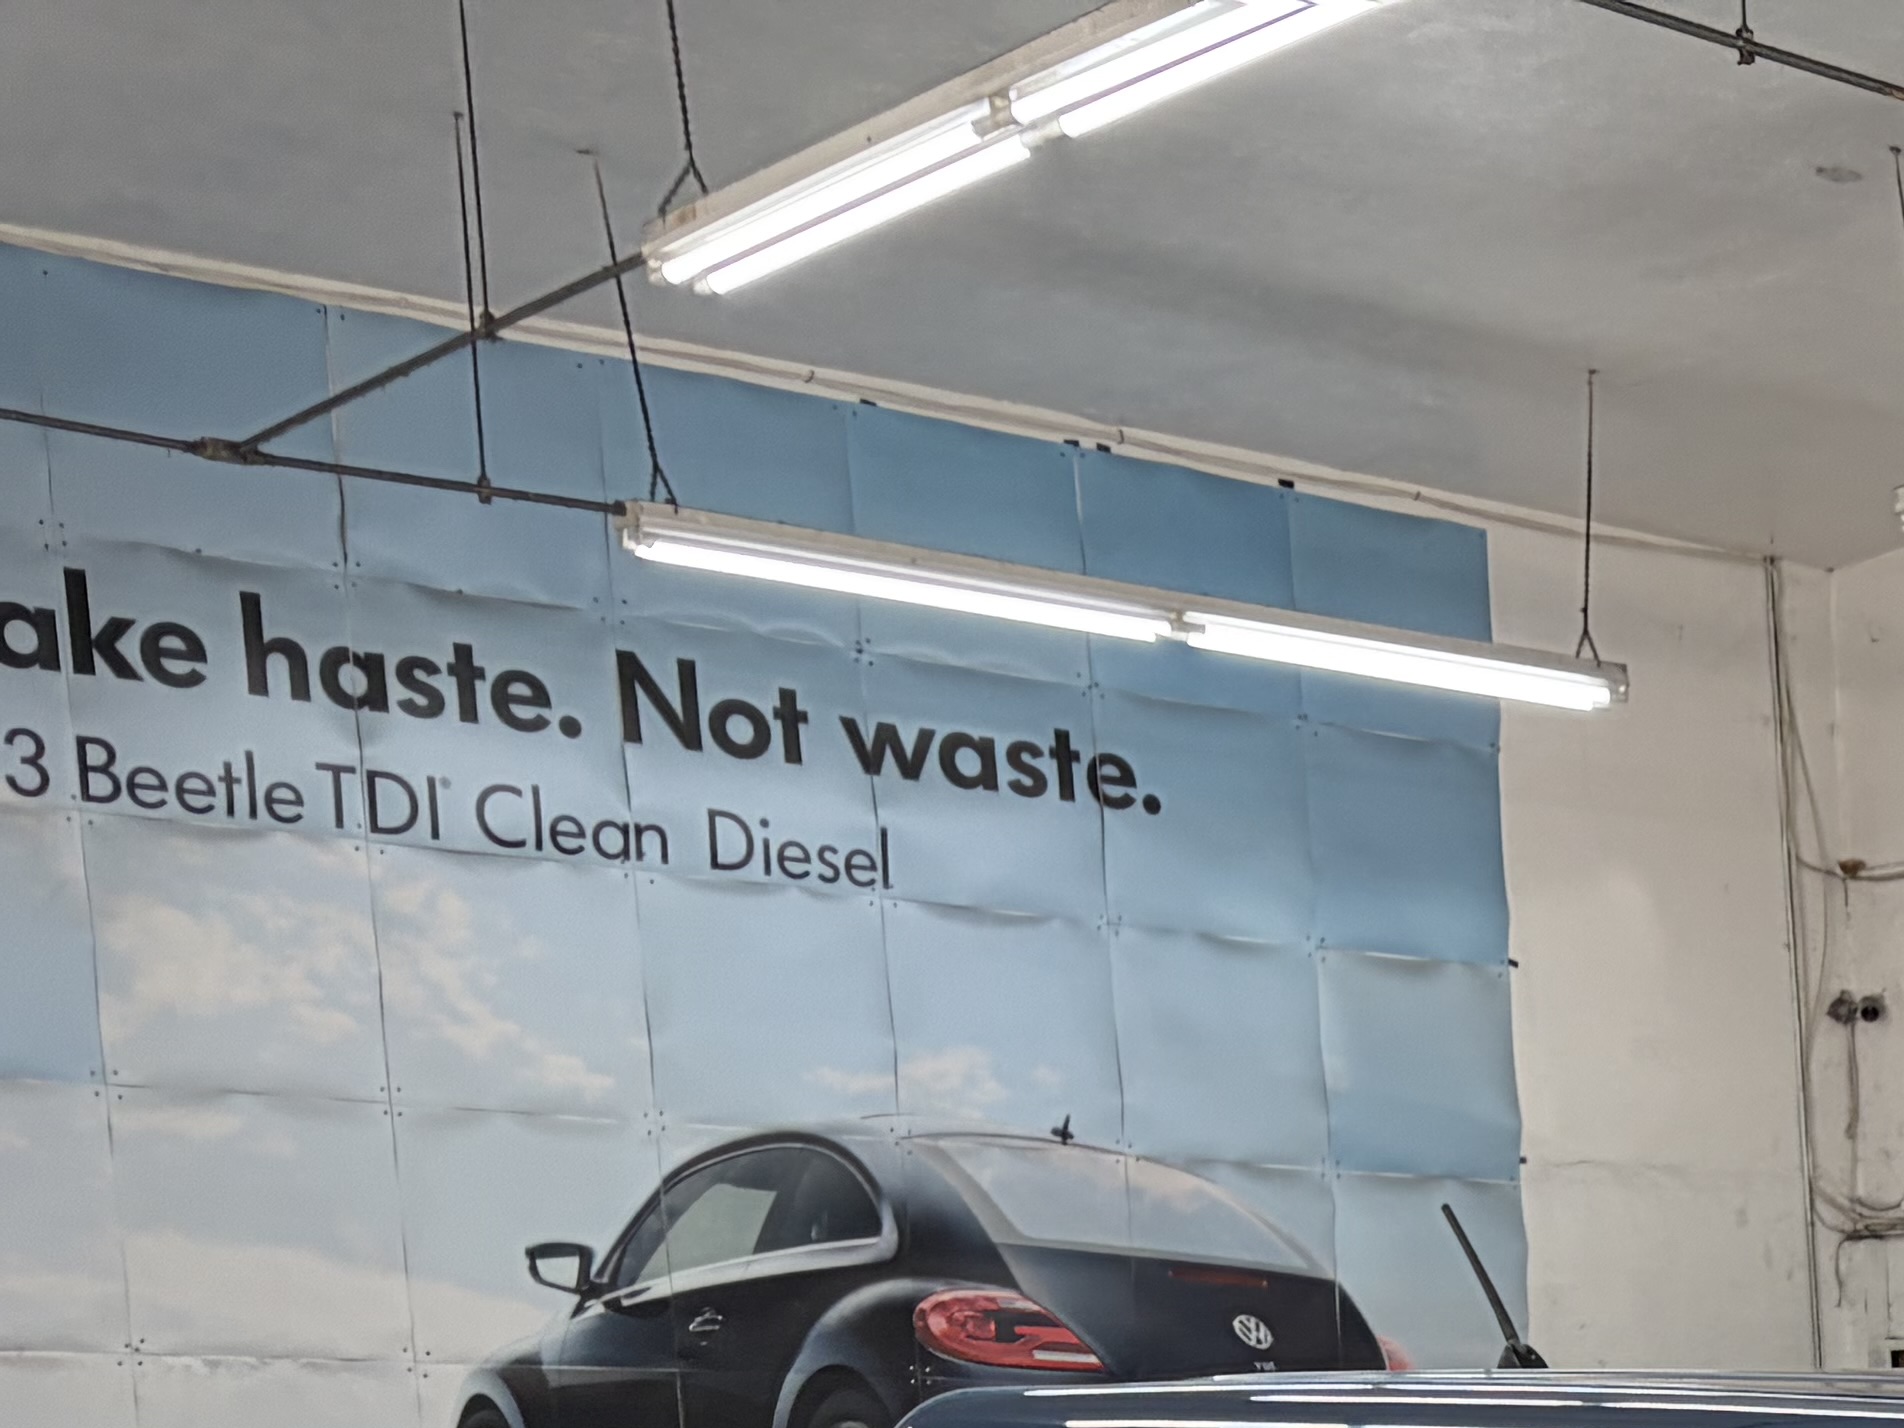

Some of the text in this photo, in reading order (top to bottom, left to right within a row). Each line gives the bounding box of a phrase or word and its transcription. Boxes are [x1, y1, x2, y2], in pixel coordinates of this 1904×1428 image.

[239, 591, 583, 739] haste.
[615, 649, 809, 765] Not
[839, 714, 1162, 815] waste.
[3, 727, 51, 797] 3
[75, 735, 305, 823] Beetle
[476, 783, 669, 865] Clean
[707, 808, 893, 890] Diesel
